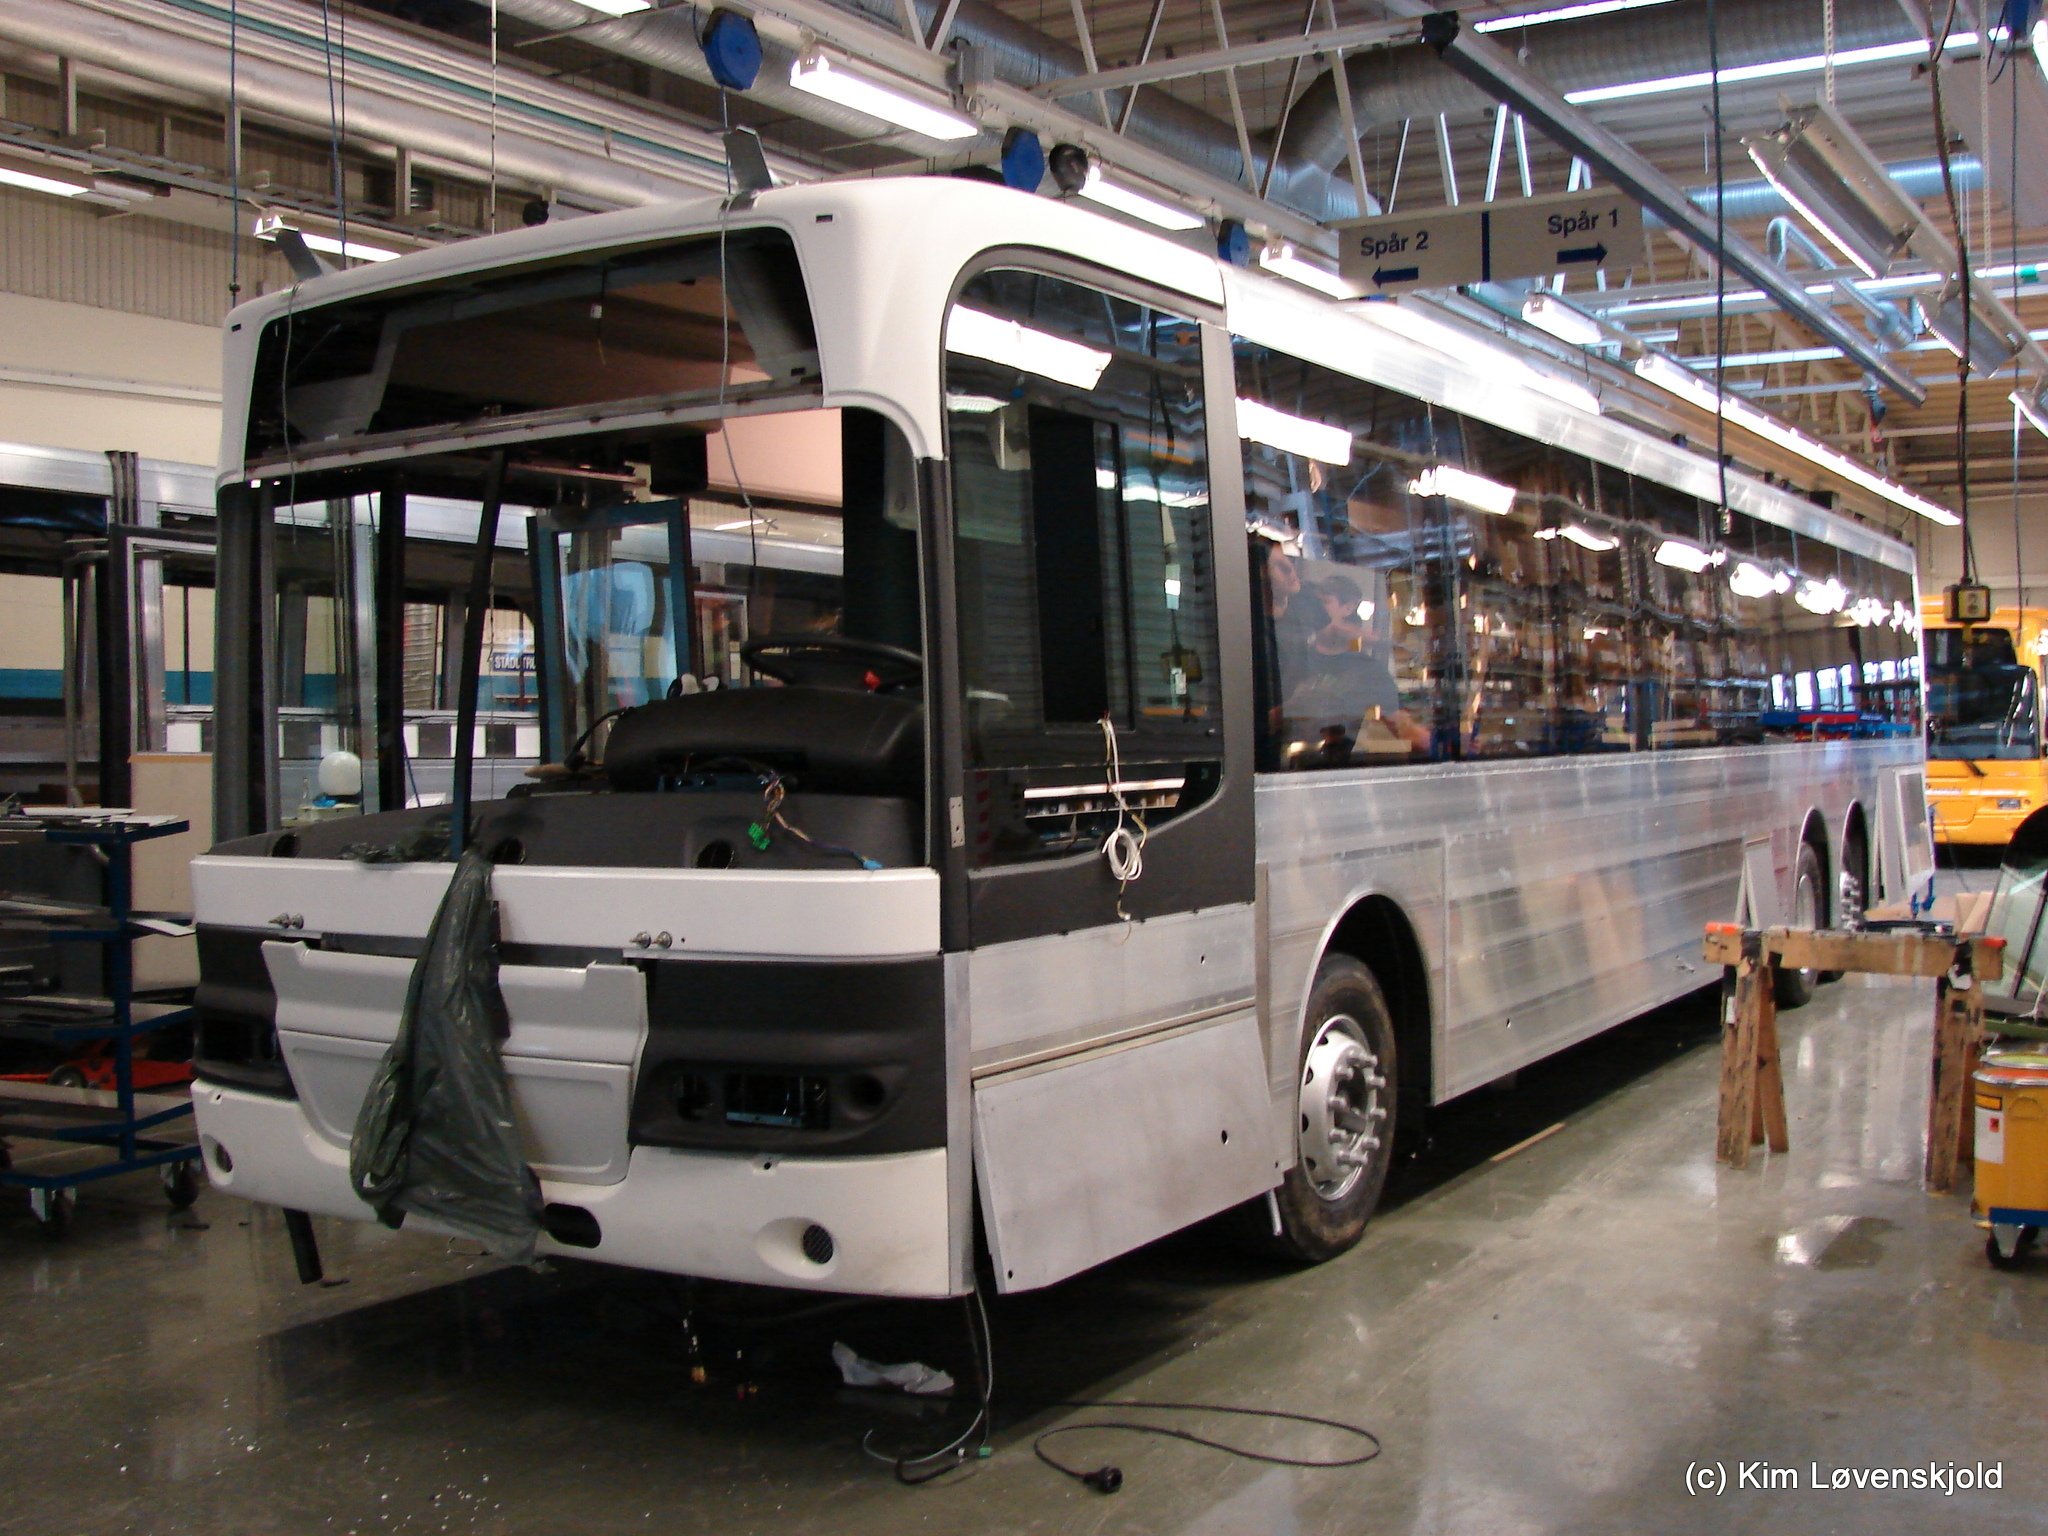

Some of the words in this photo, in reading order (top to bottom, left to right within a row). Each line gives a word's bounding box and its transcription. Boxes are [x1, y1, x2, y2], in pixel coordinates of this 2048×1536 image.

[1548, 210, 1598, 238] Spår
[1608, 208, 1618, 228] 1
[1361, 232, 1408, 260] Spår
[1416, 230, 1429, 250] 2
